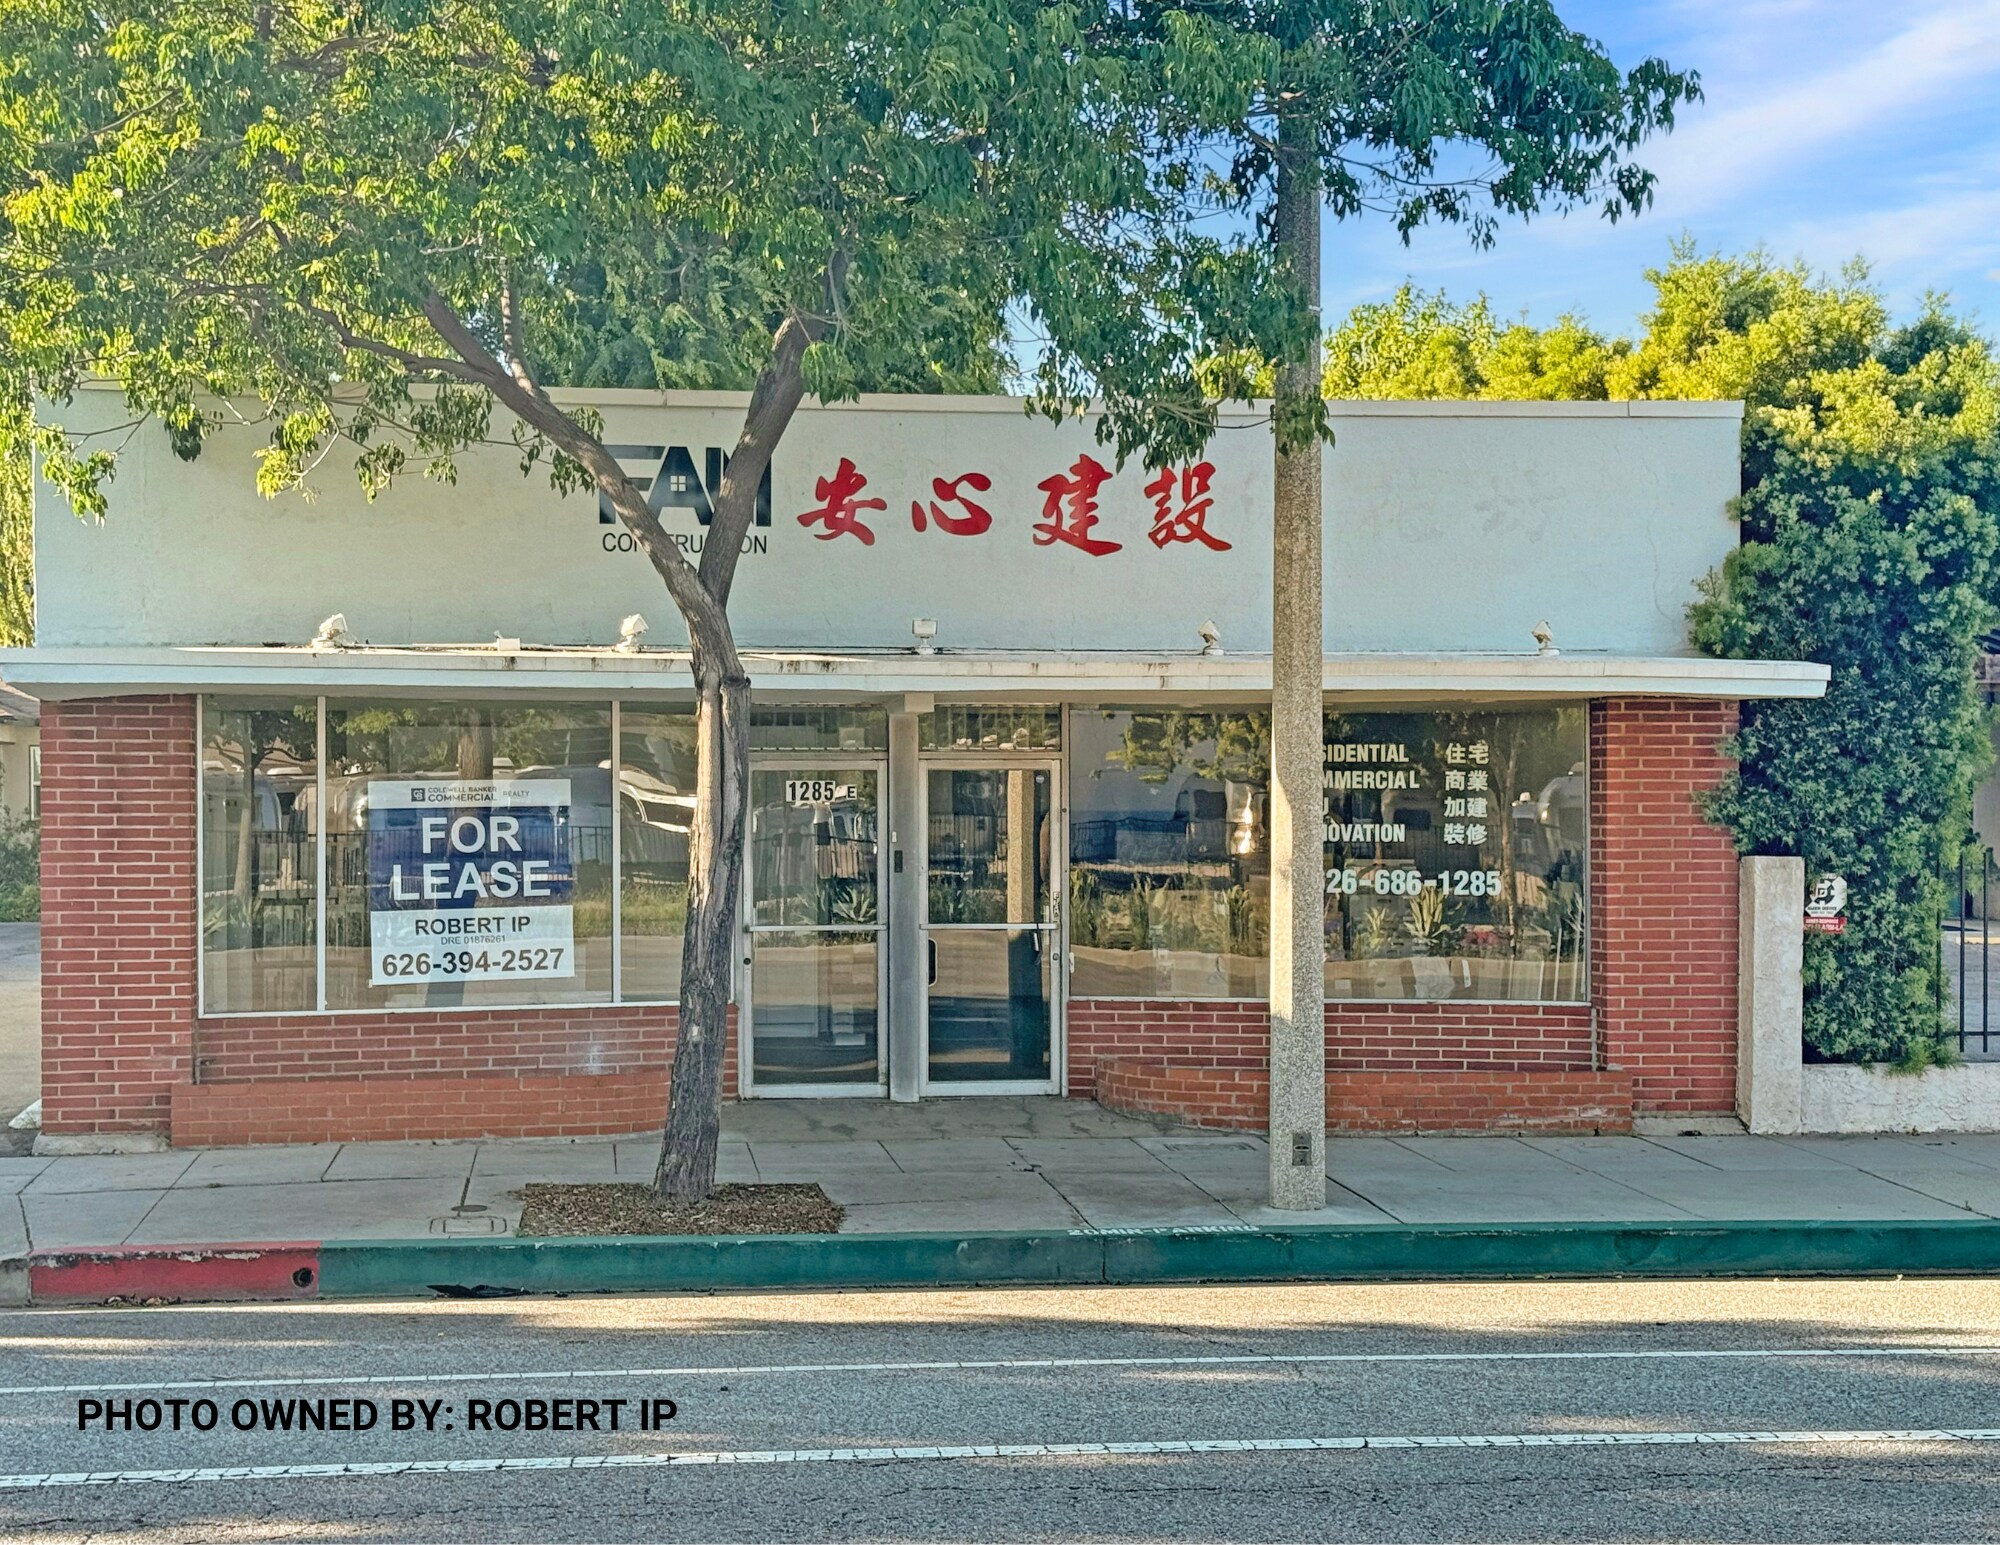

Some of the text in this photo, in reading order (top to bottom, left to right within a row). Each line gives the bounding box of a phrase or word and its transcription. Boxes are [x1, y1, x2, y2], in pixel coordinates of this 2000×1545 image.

[799, 454, 1231, 557] 安心建設
[1323, 744, 1409, 763] IDENTIAL
[1446, 742, 1489, 764] 住宅
[1323, 770, 1420, 789] MMERCIAL
[1444, 770, 1488, 791] 商業
[428, 793, 497, 802] COMMERCIAL
[789, 781, 833, 801] 1285
[848, 786, 856, 798] E
[1444, 797, 1488, 818] 加建
[422, 816, 522, 854] FOR
[1323, 824, 1406, 842] OVATION
[1443, 823, 1488, 845] 裝修
[392, 860, 551, 901] LEASE
[1324, 868, 1501, 896] 26-686-1285
[415, 916, 530, 936] ROBERT IP
[441, 935, 506, 946] DRE 01876261
[382, 948, 565, 977] 626-394-2527
